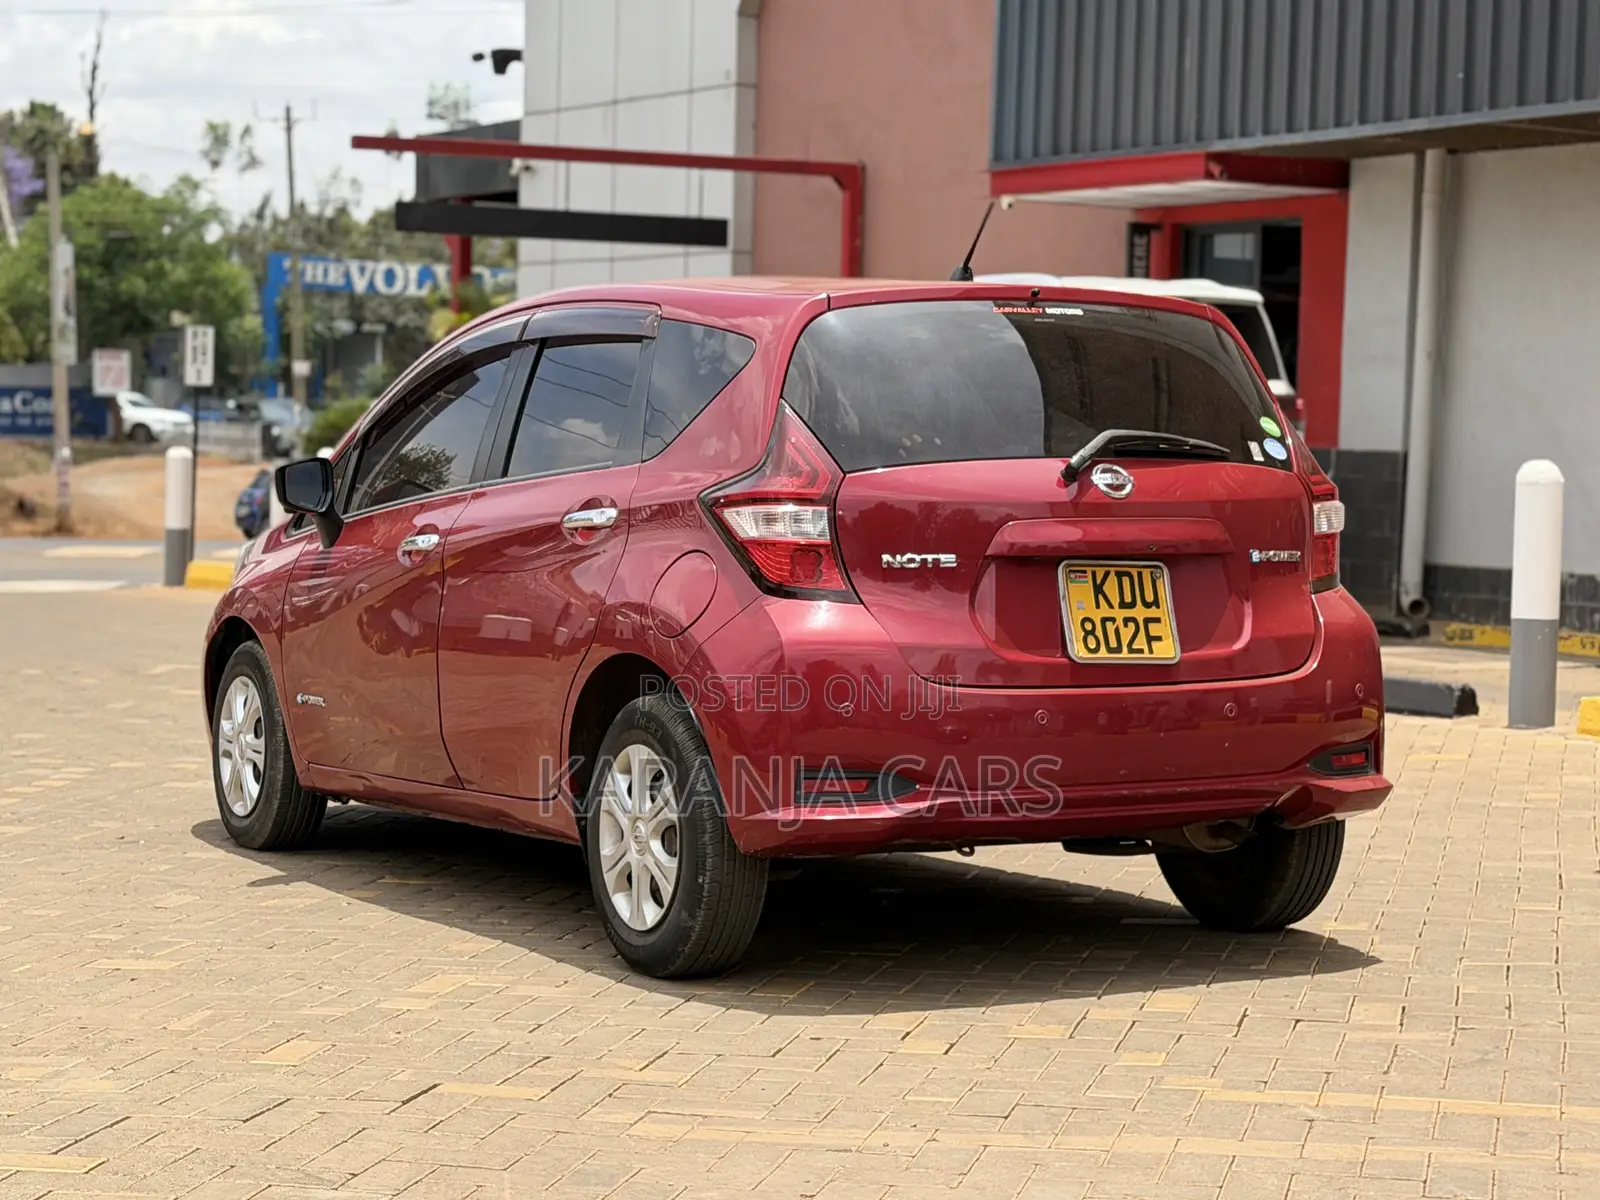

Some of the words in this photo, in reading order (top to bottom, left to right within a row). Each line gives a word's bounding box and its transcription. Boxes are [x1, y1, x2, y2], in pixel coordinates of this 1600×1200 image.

[881, 553, 958, 568] NOTE
[1091, 570, 1160, 609] KDU
[1080, 616, 1163, 655] 802F
